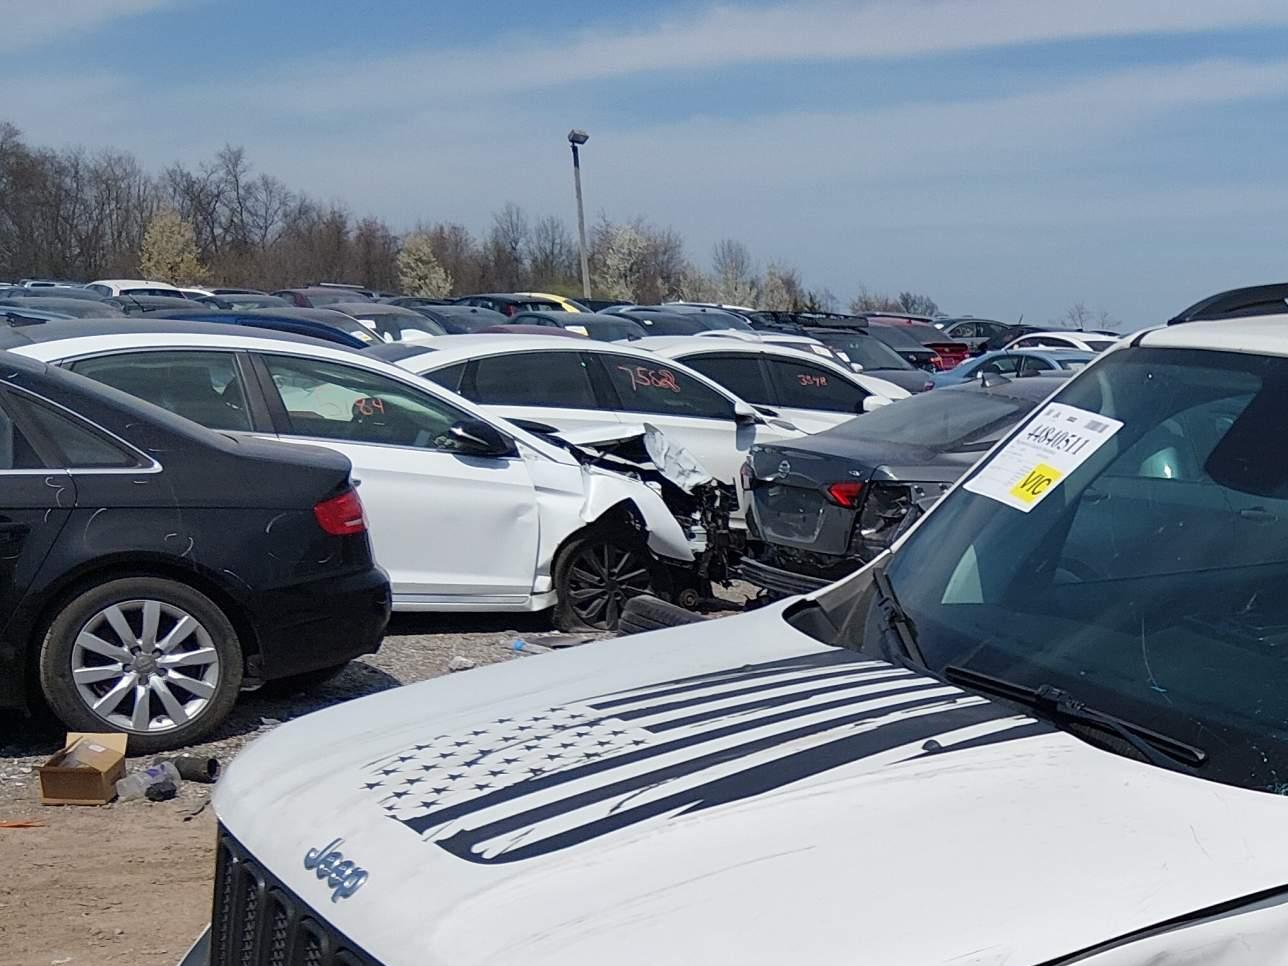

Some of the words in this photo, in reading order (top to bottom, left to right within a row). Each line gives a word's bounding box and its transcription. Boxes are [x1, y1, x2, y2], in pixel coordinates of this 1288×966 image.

[1026, 423, 1090, 456] 44840511
[1019, 470, 1053, 496] VIC
[303, 837, 368, 904] Jeep
